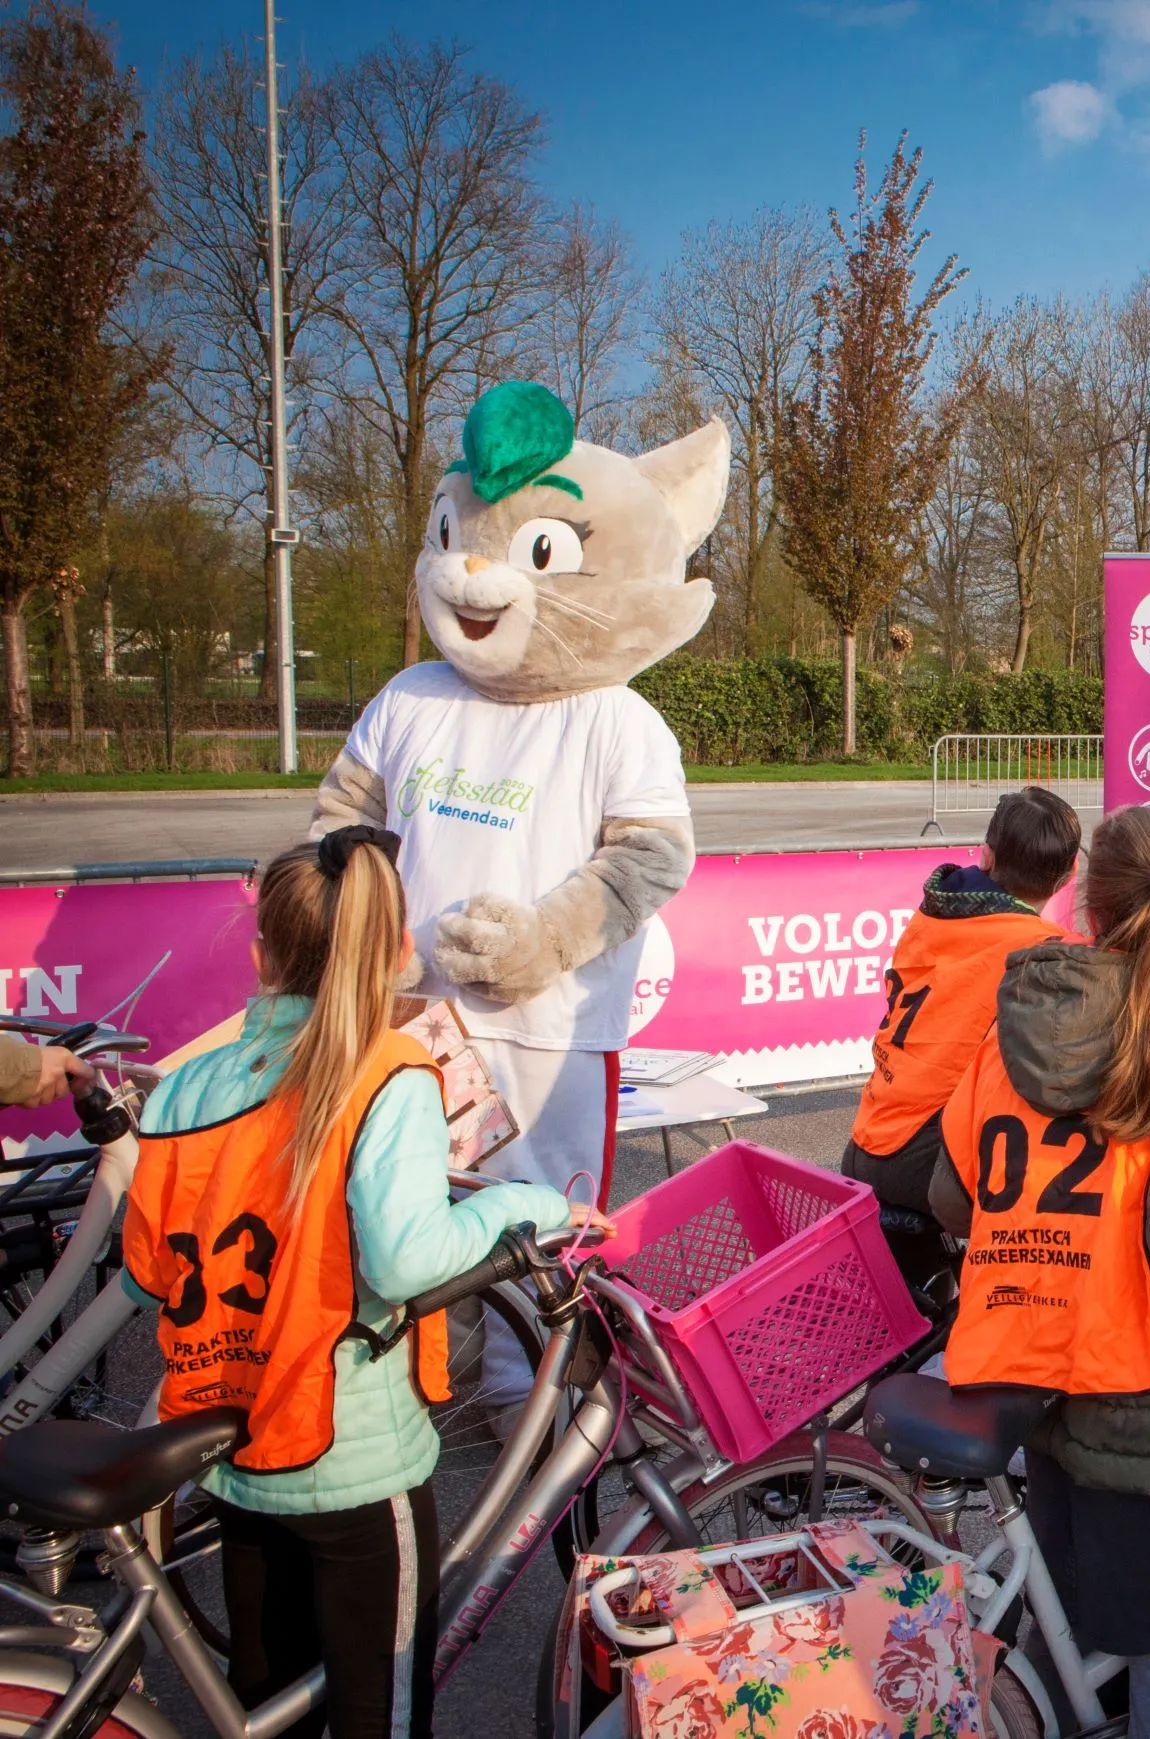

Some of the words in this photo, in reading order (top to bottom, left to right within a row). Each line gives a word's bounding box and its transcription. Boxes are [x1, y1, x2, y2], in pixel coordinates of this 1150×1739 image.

[428, 798, 515, 831] Veenendaal
[740, 954, 893, 1005] BEWE
[977, 1113, 1104, 1217] 02
[991, 1228, 1071, 1247] PRAKTISCH
